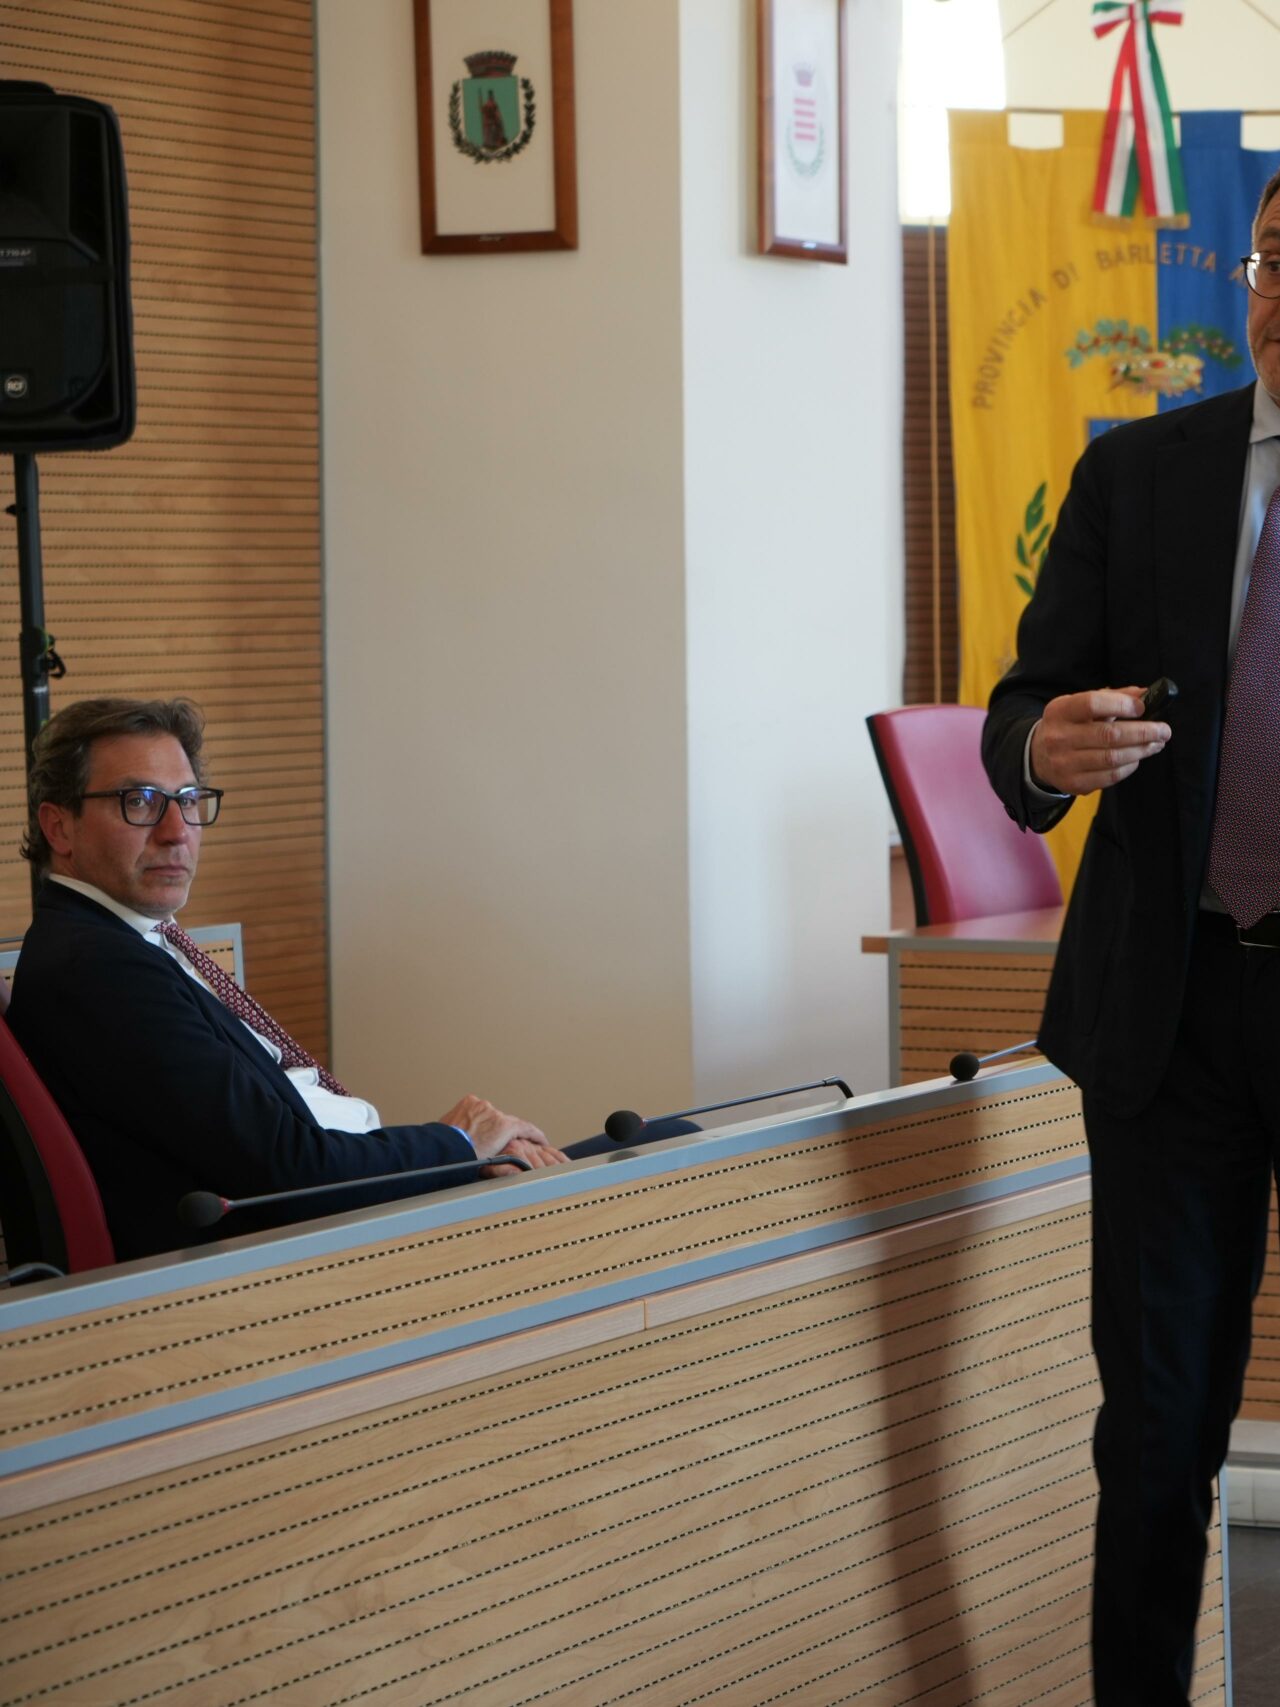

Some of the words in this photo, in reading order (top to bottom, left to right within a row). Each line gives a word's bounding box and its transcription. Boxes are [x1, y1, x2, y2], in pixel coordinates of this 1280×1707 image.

[971, 287, 1048, 411] PROVINCIA
[1051, 261, 1081, 290] DI
[1095, 242, 1217, 273] BARLETTA
